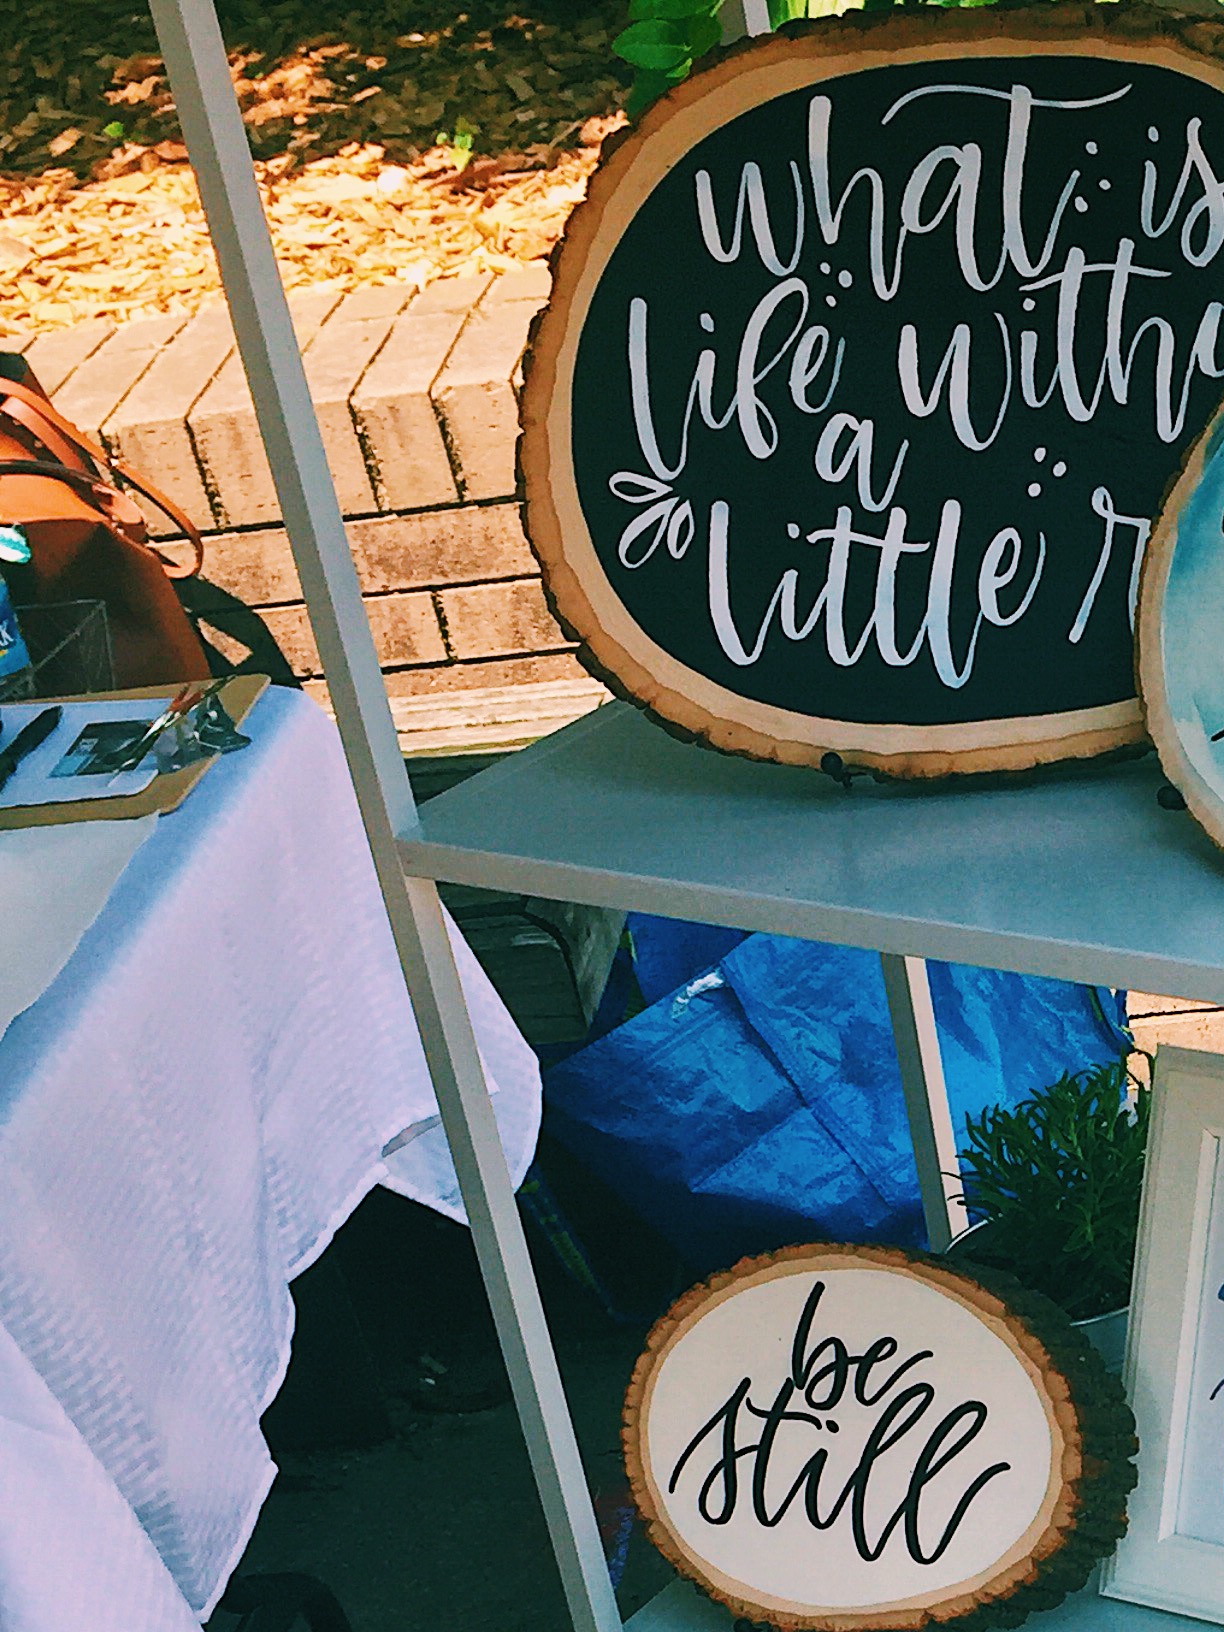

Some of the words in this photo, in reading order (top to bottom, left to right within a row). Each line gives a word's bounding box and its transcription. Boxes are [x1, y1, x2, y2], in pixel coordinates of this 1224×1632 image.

[696, 84, 1132, 300] what
[628, 278, 846, 480] life
[814, 412, 910, 513] a
[708, 500, 1046, 689] little
[790, 1282, 935, 1408] be
[668, 1377, 1011, 1565] still
